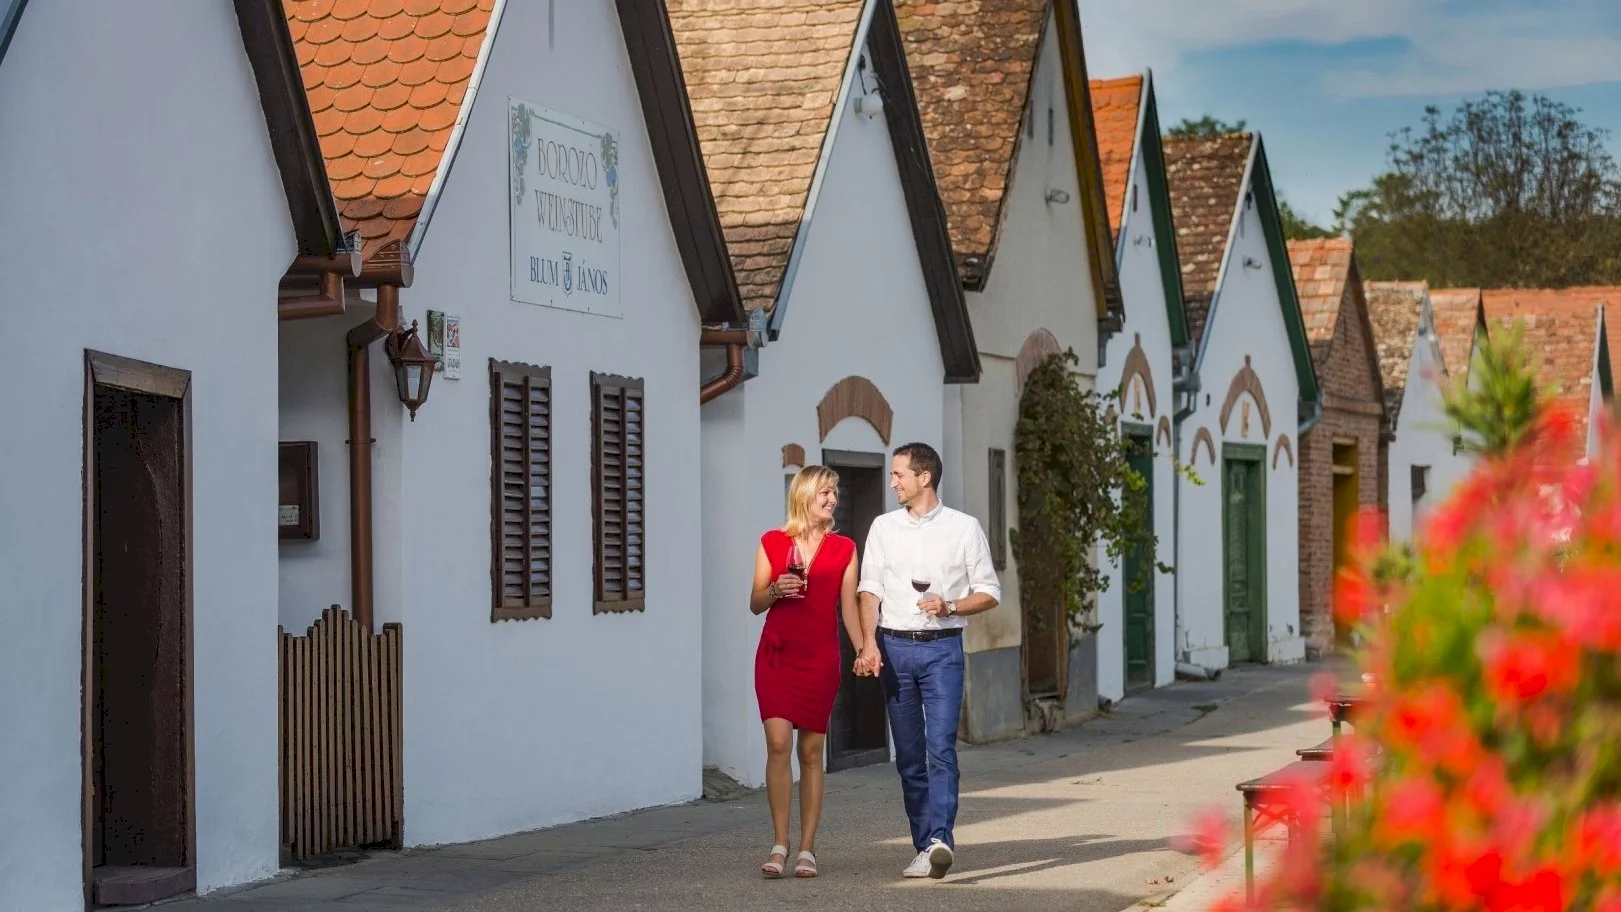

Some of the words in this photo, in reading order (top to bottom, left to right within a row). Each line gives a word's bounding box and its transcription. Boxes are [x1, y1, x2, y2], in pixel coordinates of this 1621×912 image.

[534, 189, 602, 243] WEINSTUBE
[530, 256, 558, 286] BLUM
[576, 259, 608, 295] JÁNOS
